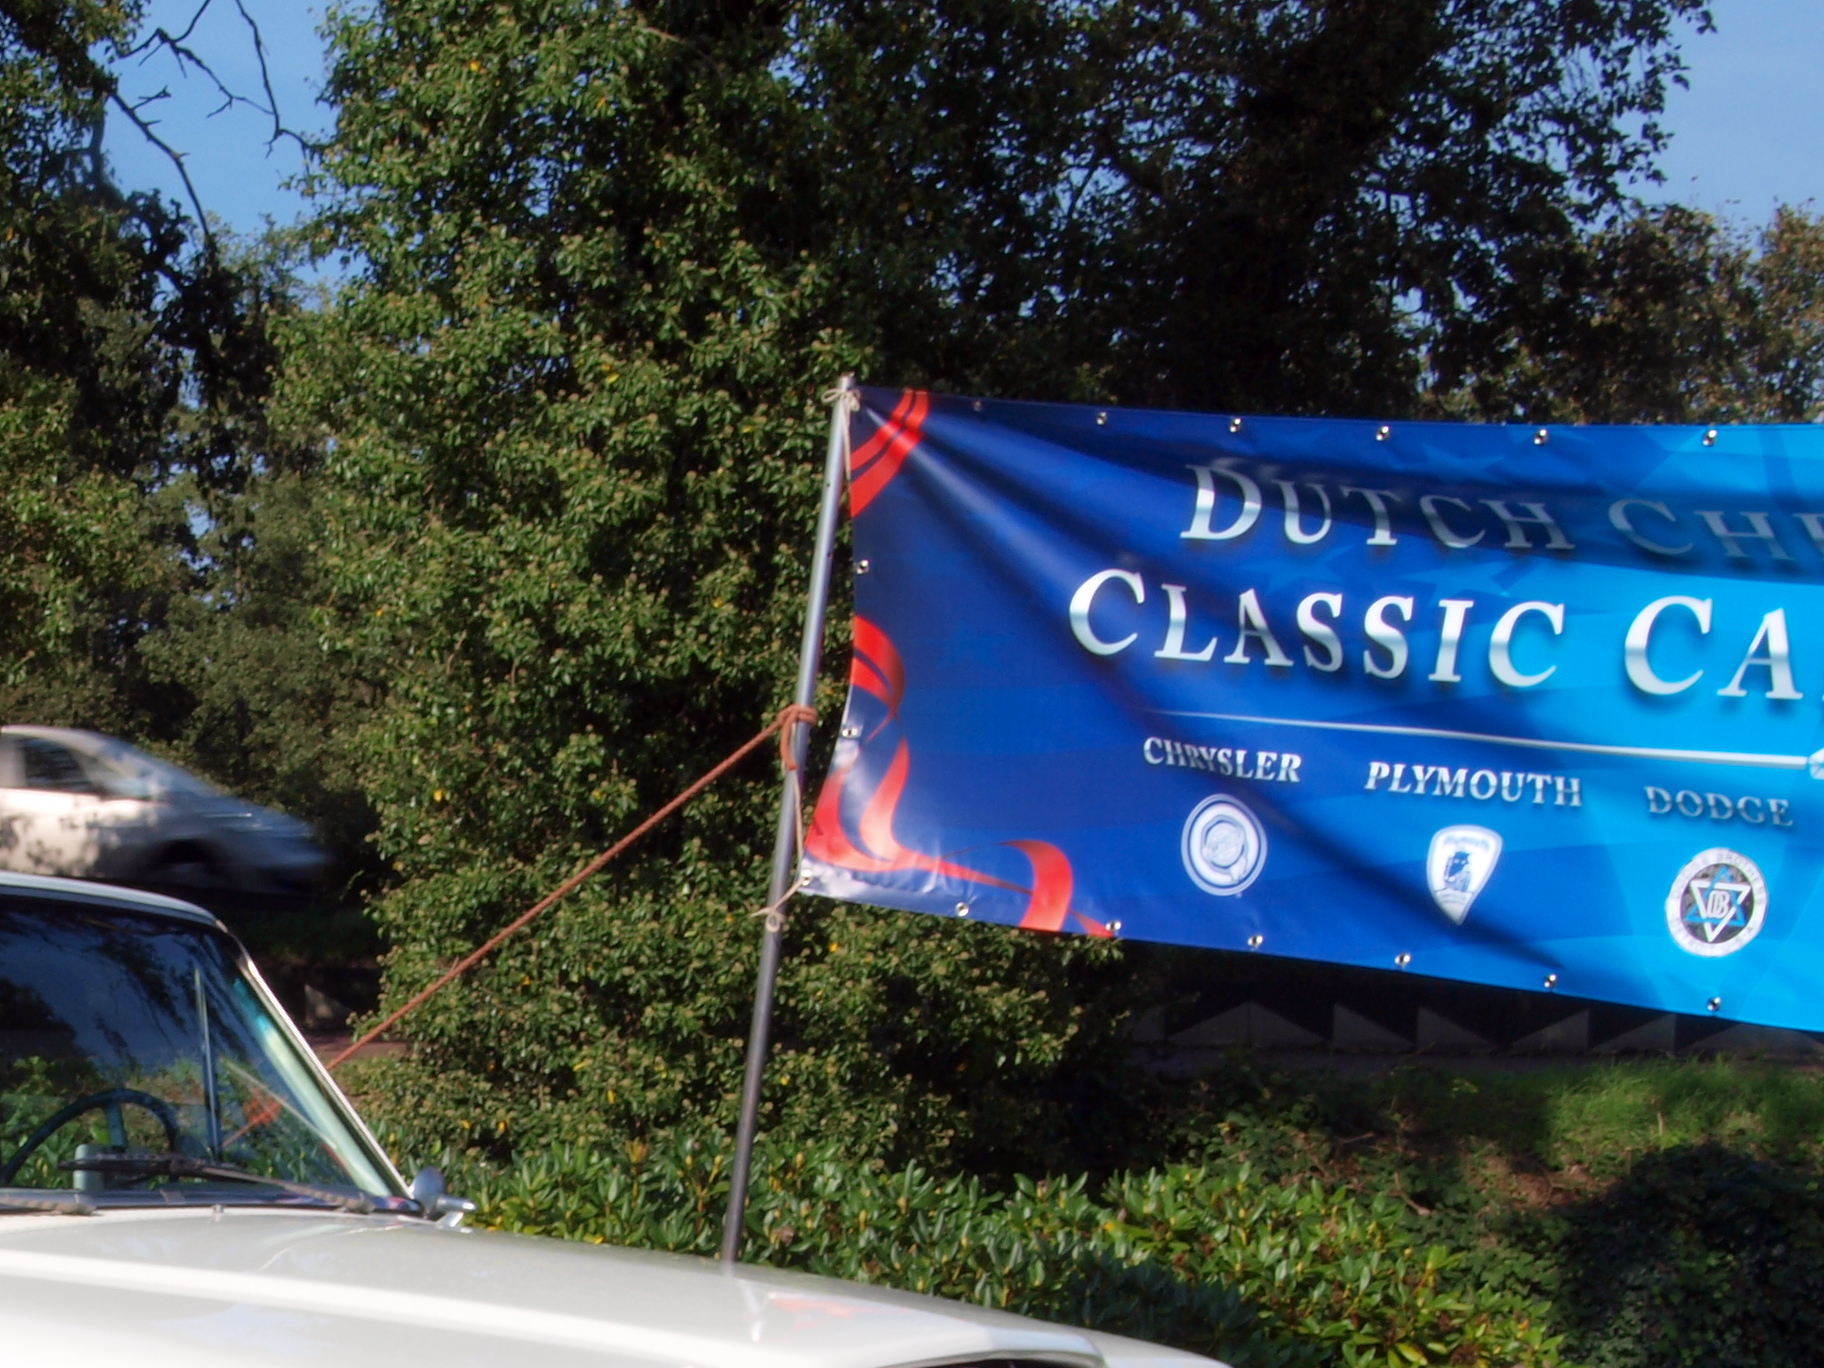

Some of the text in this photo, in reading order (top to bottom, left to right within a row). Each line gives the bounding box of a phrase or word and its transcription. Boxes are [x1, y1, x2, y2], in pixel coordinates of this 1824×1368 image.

[1179, 463, 1574, 551] DUTCH
[1068, 567, 1824, 701] CLASSIC CA
[1142, 736, 1794, 827] CHRYSLER PLYMOUTH DODGE
